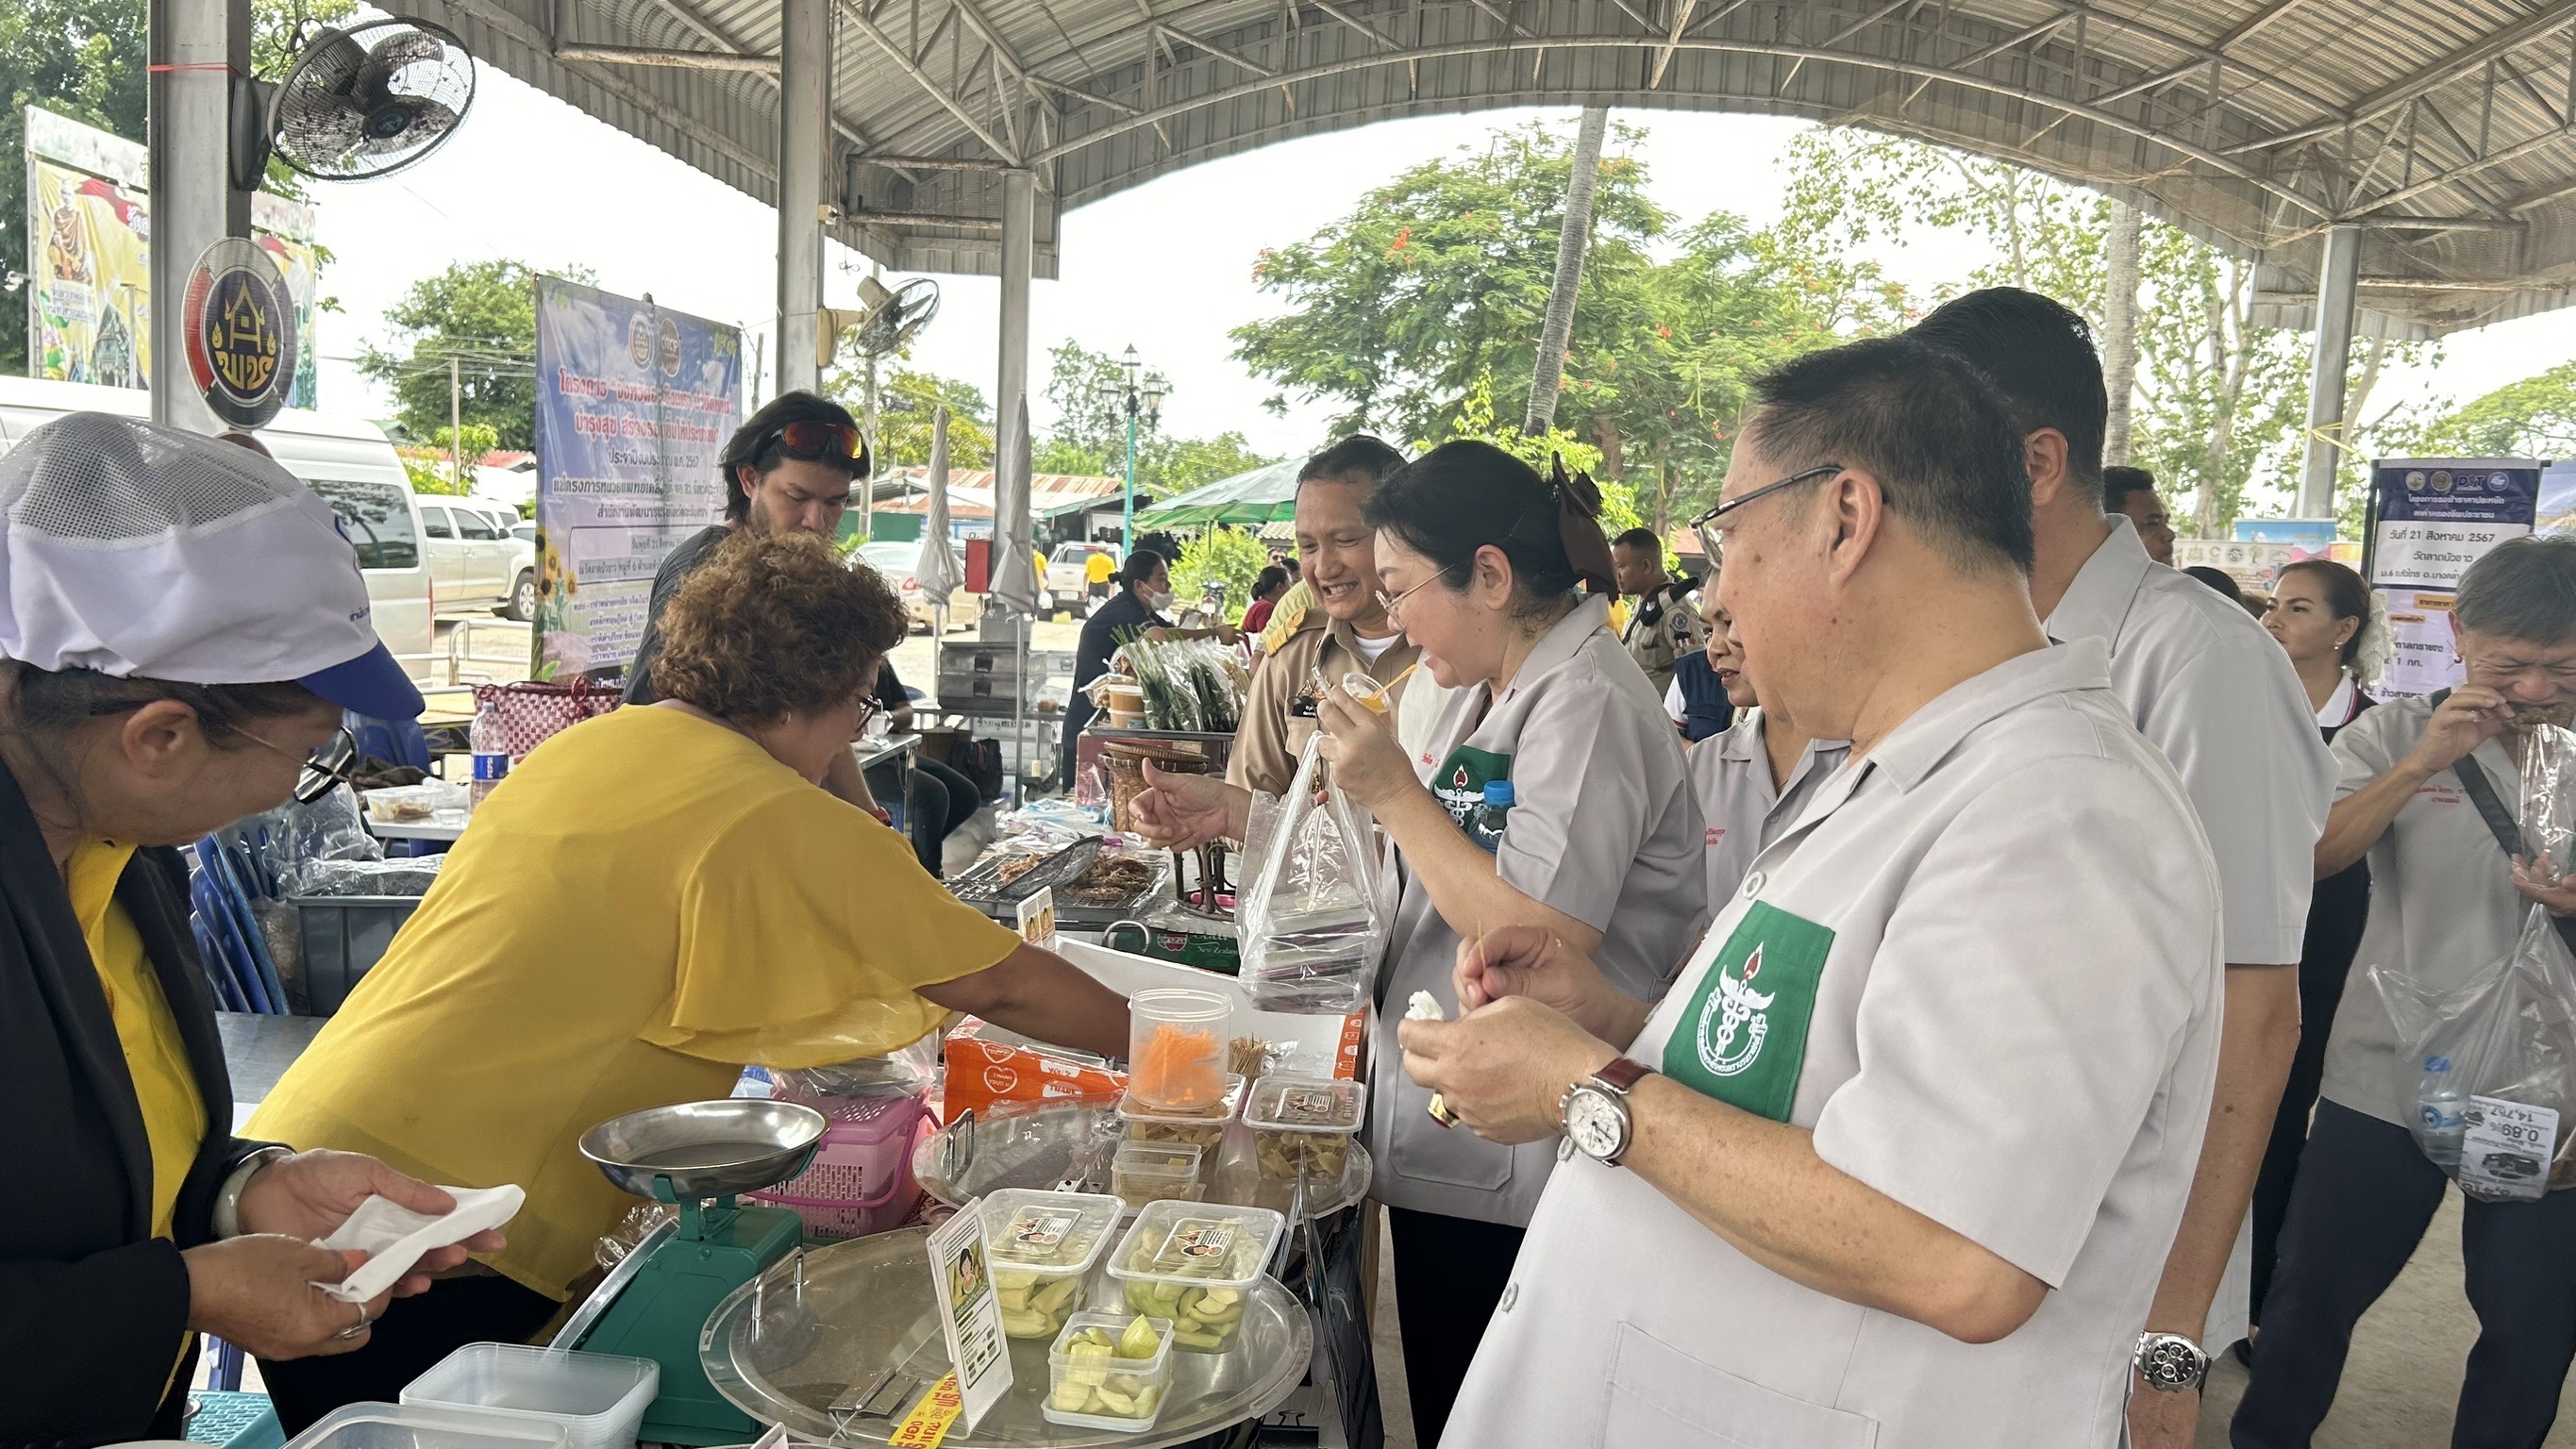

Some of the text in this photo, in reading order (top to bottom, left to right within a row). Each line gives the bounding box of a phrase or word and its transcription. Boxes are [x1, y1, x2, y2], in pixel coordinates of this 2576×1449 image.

[2390, 527, 2495, 543] วันที่ 21 สิงหาคม 2567
